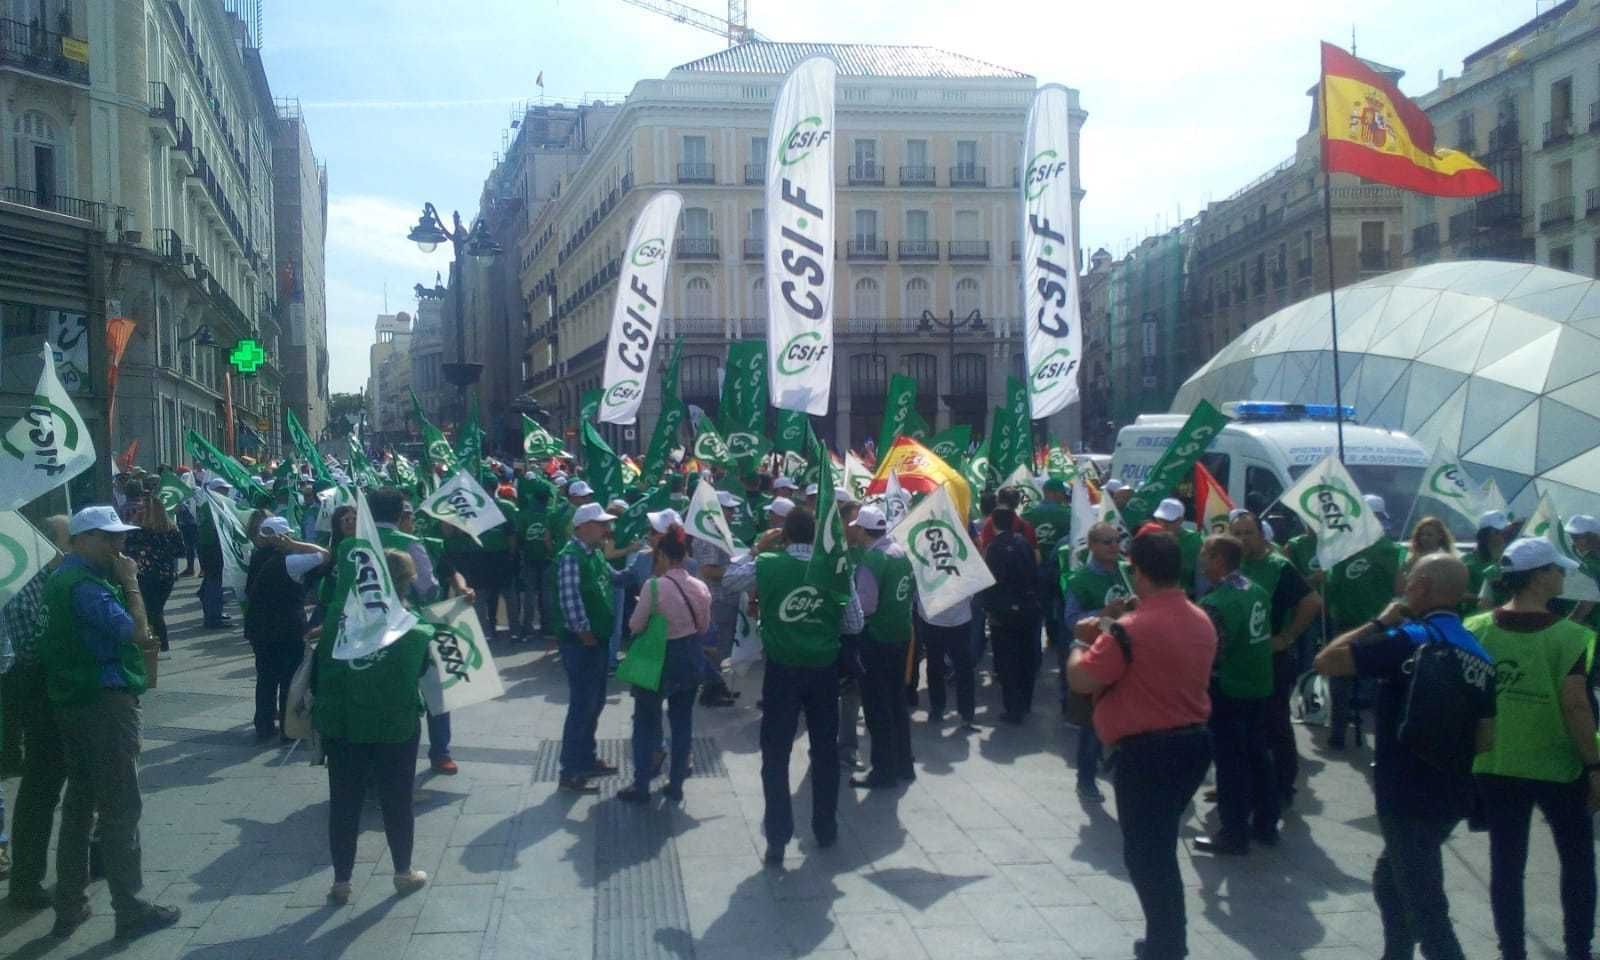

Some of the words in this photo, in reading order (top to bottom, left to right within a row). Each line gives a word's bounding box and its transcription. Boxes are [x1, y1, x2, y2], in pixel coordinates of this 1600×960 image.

[781, 177, 825, 320] CSI·F
[1030, 214, 1069, 338] CSI·F
[618, 274, 657, 373] CSI·F
